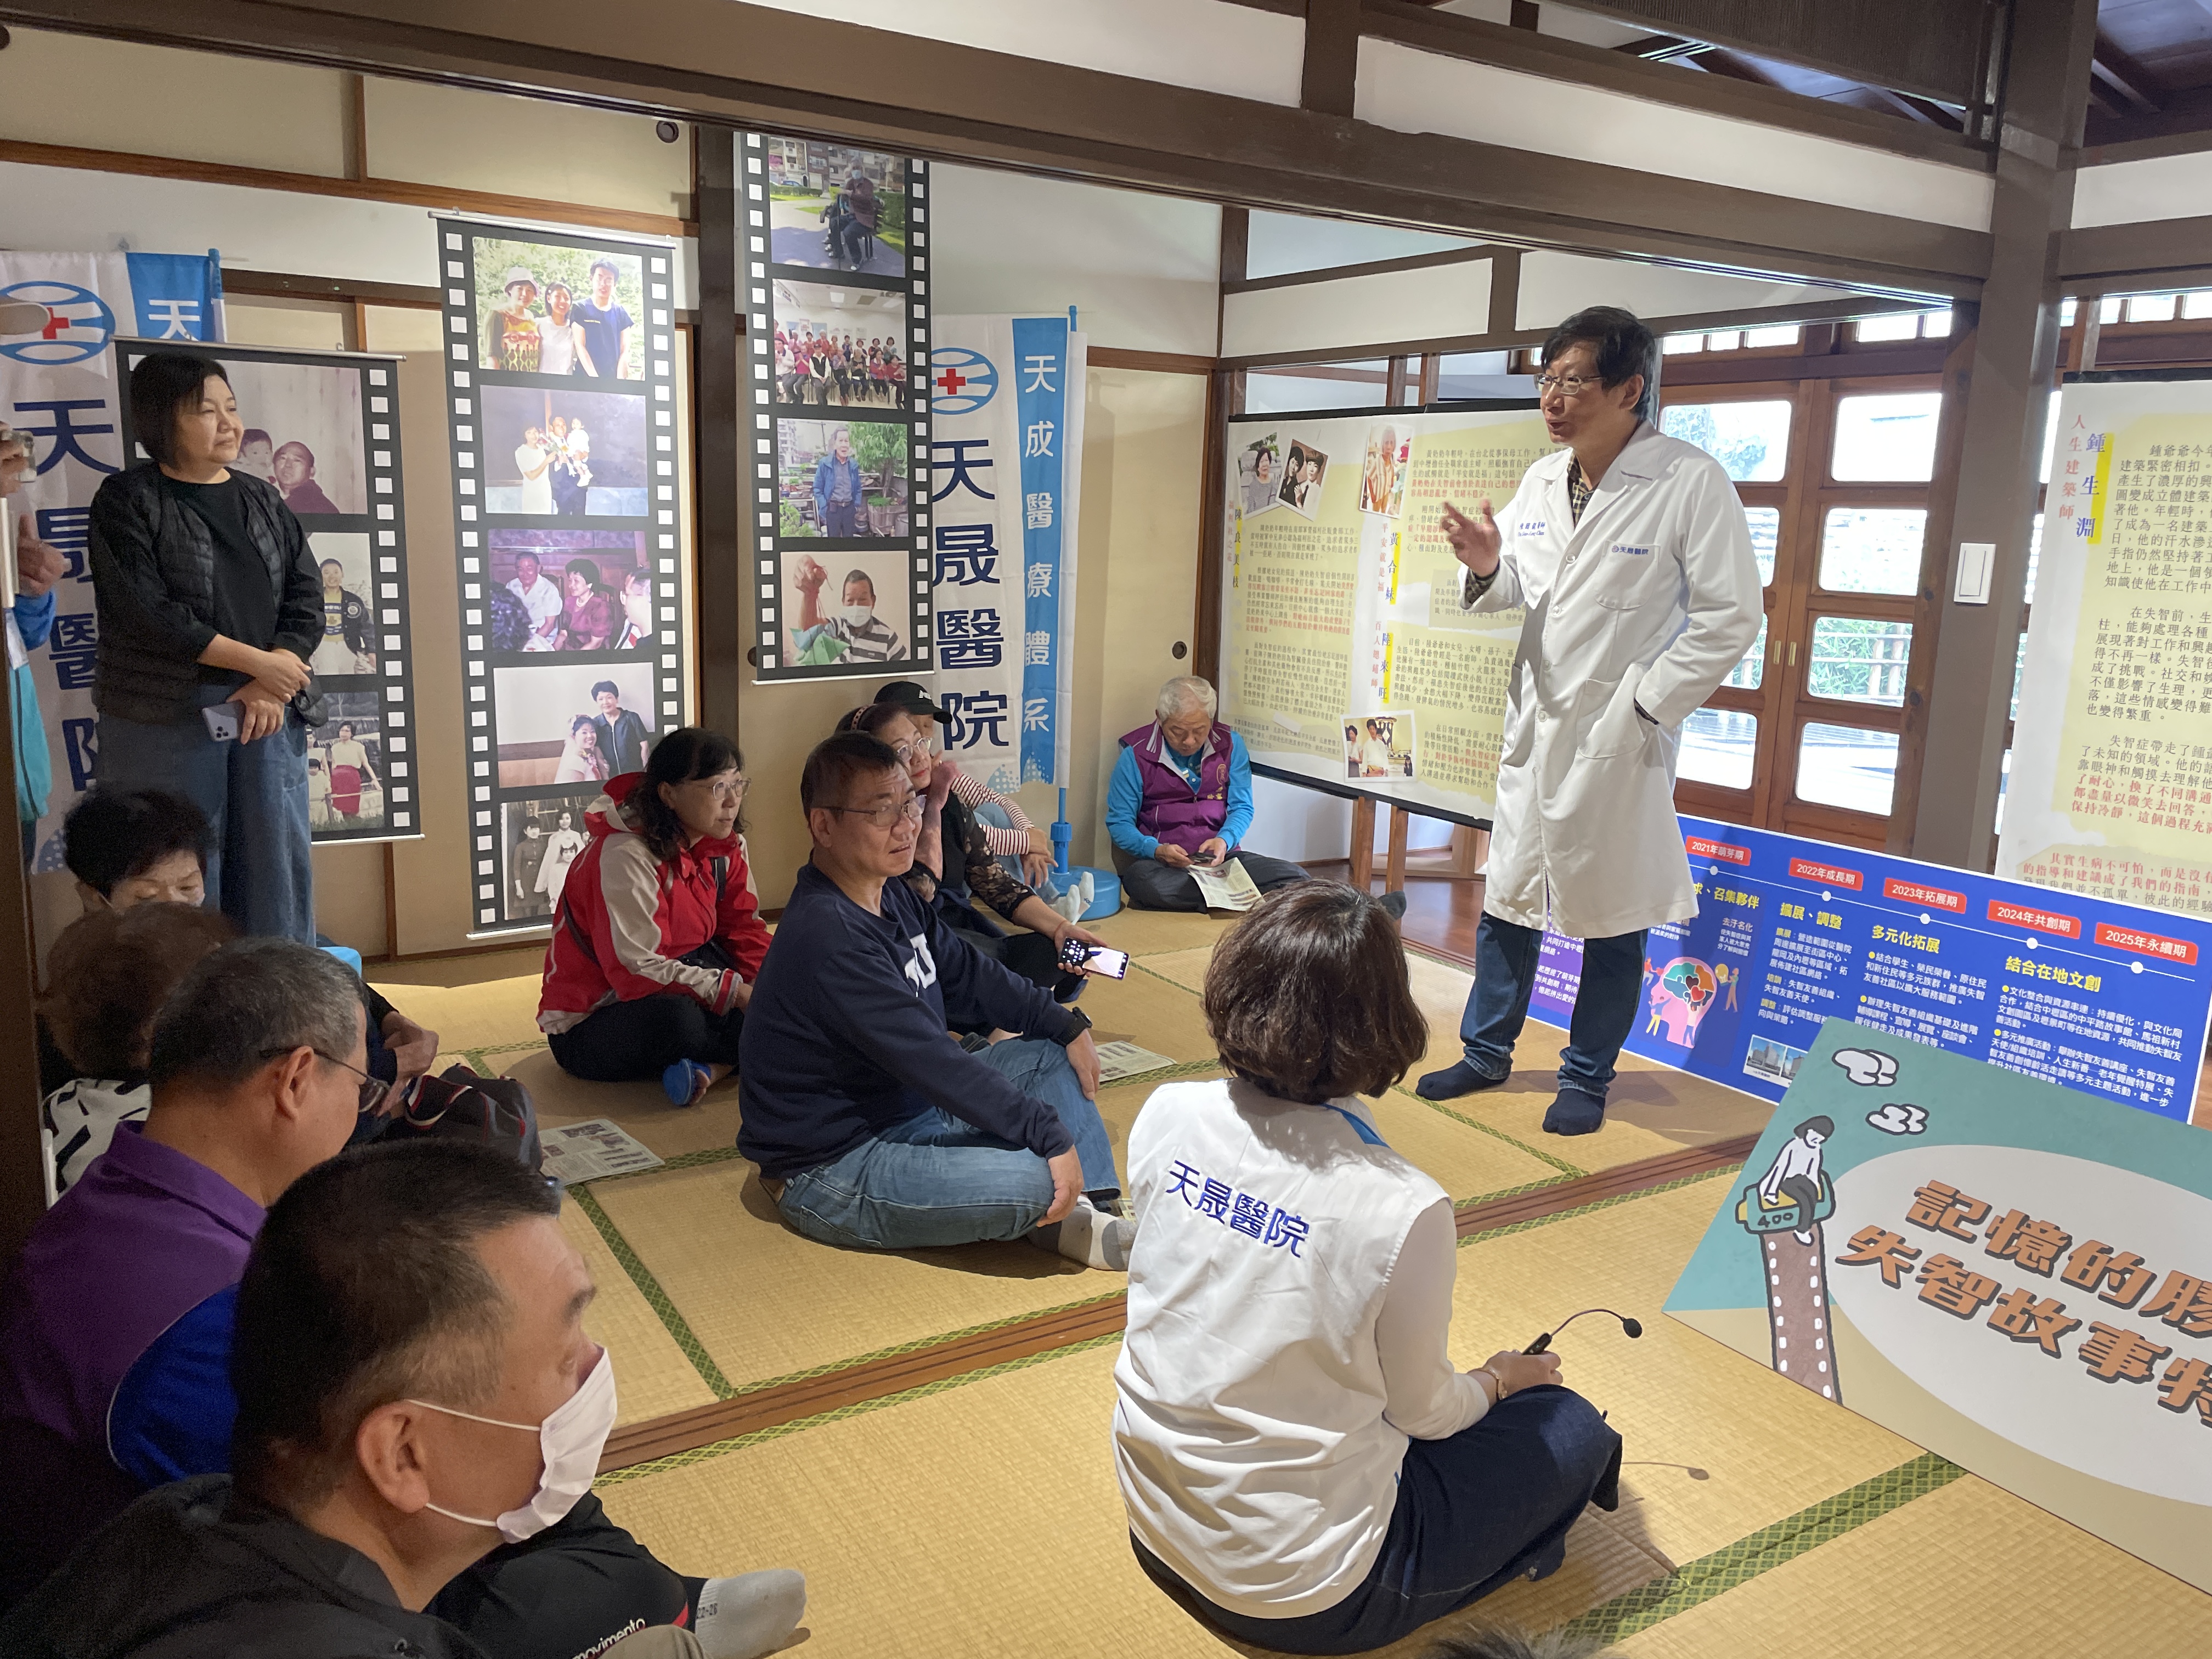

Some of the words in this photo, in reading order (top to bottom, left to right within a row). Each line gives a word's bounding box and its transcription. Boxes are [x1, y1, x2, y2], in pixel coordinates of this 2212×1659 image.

[2058, 414, 2086, 521] 人生建築師
[2119, 460, 2211, 472] 建築緊密相扣。
[2076, 433, 2106, 539] 鍾生淵
[2114, 504, 2212, 518] 著他。年輕時，
[2114, 518, 2212, 533] 了成為一名建築
[1023, 355, 1057, 733] 天成醫療體系
[1386, 533, 1398, 601] 黃合妹
[932, 439, 1009, 751] 天晟醫院
[2104, 576, 2211, 592] 知識使他在工作中
[2130, 606, 2211, 624] 在失智前，生
[1379, 633, 1391, 701] 陸來旺
[2087, 703, 2164, 721] 也變得繁重。
[1691, 842, 1745, 861] 2021年萌芽期
[1797, 864, 1856, 885] 2022年成長期
[1892, 884, 1958, 908] 2023年拓展期
[1997, 907, 2071, 933] 2024年共創期
[1872, 925, 1940, 954] 多元化拓展
[2106, 930, 2187, 958] 2025年永續期
[2005, 956, 2102, 992] 結合在地文創
[1165, 1159, 1310, 1259] 天晟醫院
[1758, 1212, 1793, 1228] 400
[572, 1618, 646, 1659] movimento
